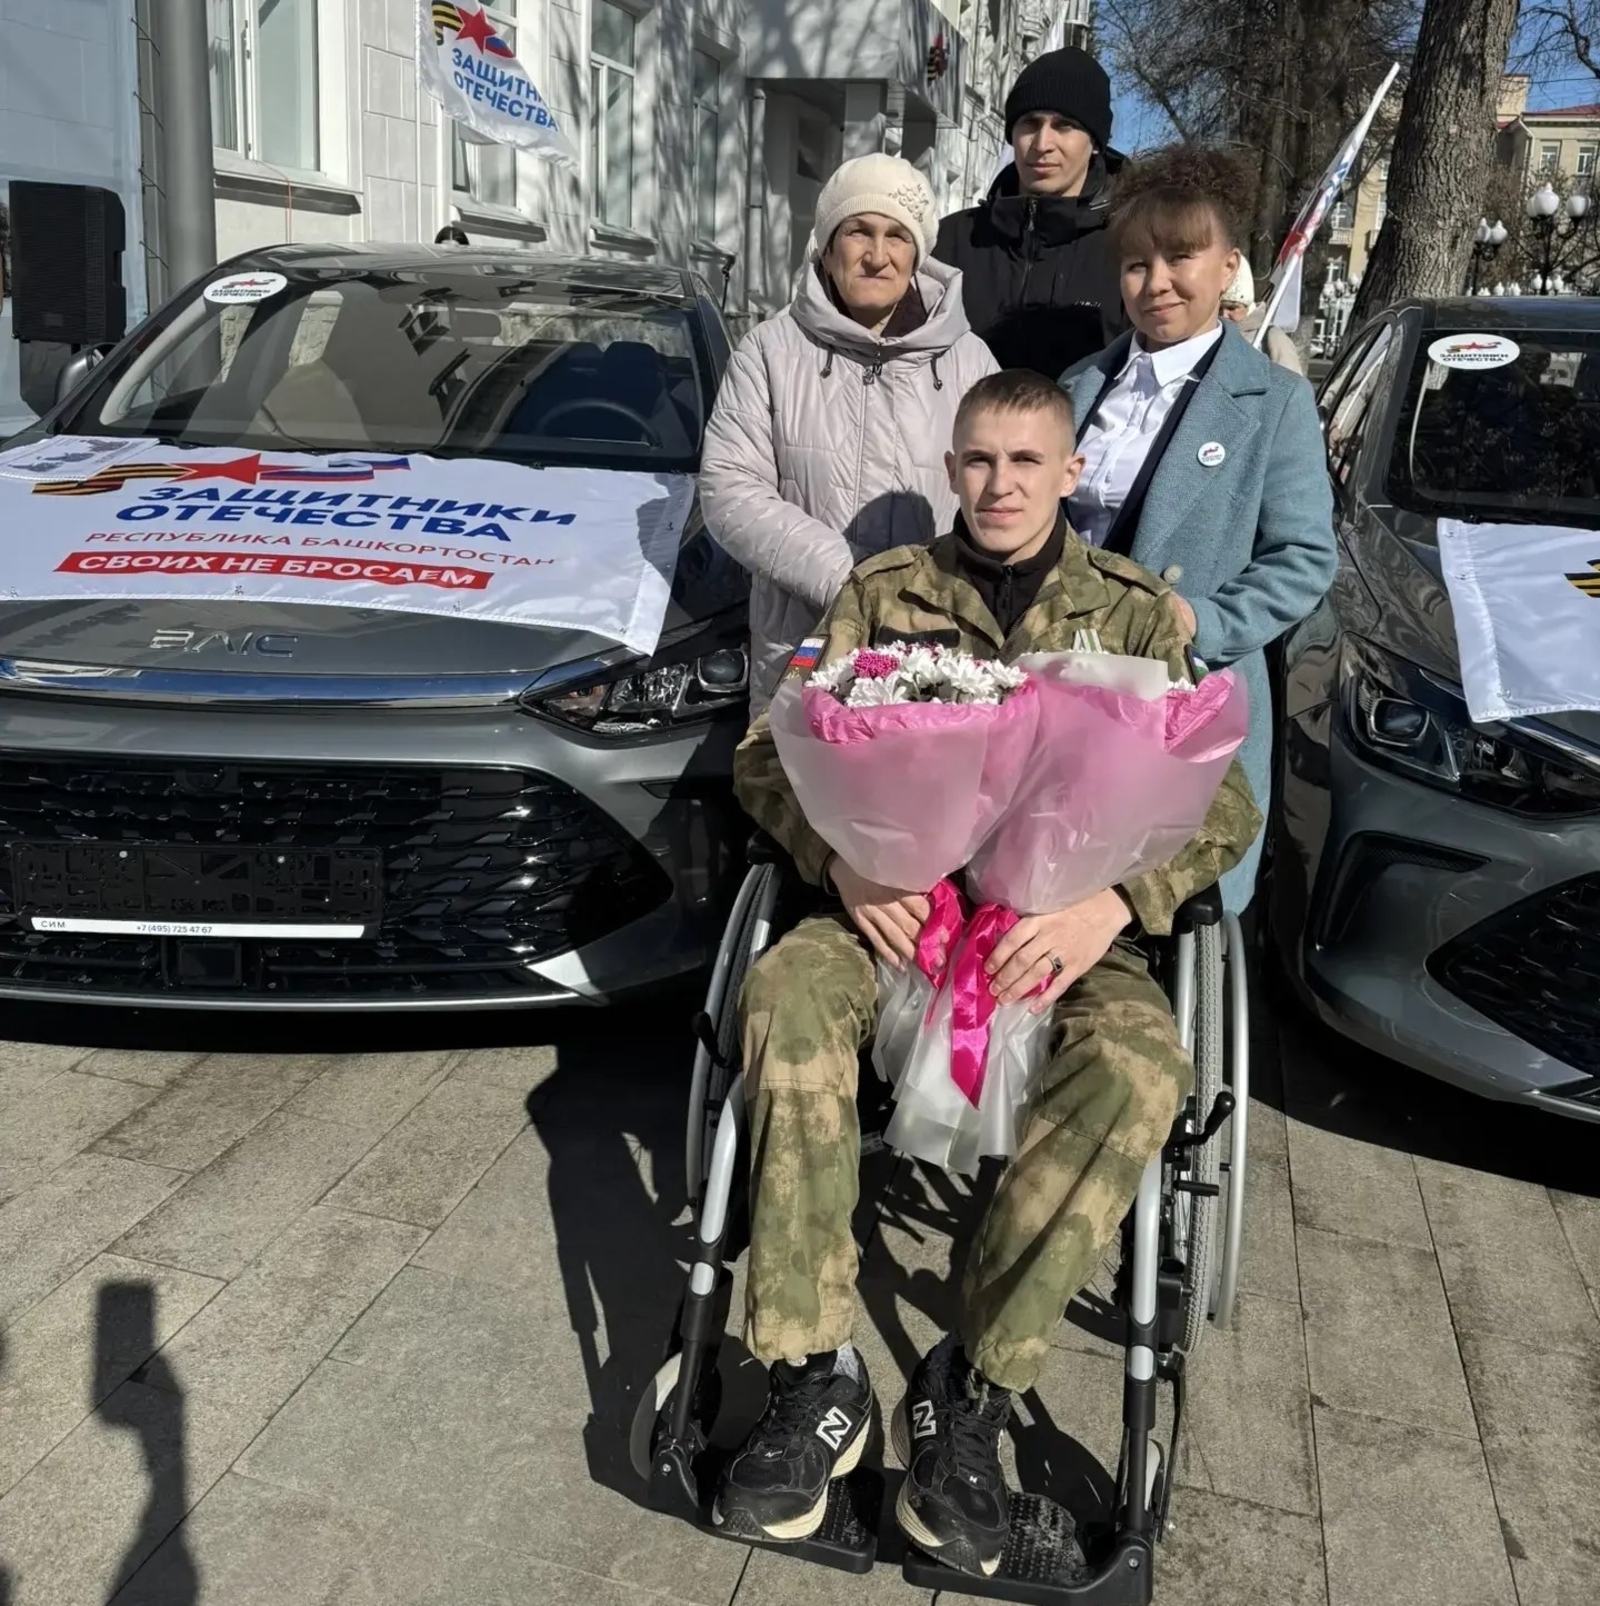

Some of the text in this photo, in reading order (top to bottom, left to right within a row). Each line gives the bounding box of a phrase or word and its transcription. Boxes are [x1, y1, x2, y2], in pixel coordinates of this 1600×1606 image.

[453, 70, 559, 133] ОТЕЧЕСТВА
[115, 504, 512, 542] ОТЕЧЕСТВА
[137, 486, 577, 526] ЗАЩИТНИКИ
[85, 532, 555, 566] РЕСПУБЛИКА БАШКОРТОСТАН
[77, 555, 477, 586] СВОИХ НЕ БРОСАЕМ
[150, 628, 299, 658] BAIC
[40, 920, 66, 929] СИМ
[136, 924, 213, 934] +7 (495) 725 47 67
[815, 1405, 853, 1452] N
